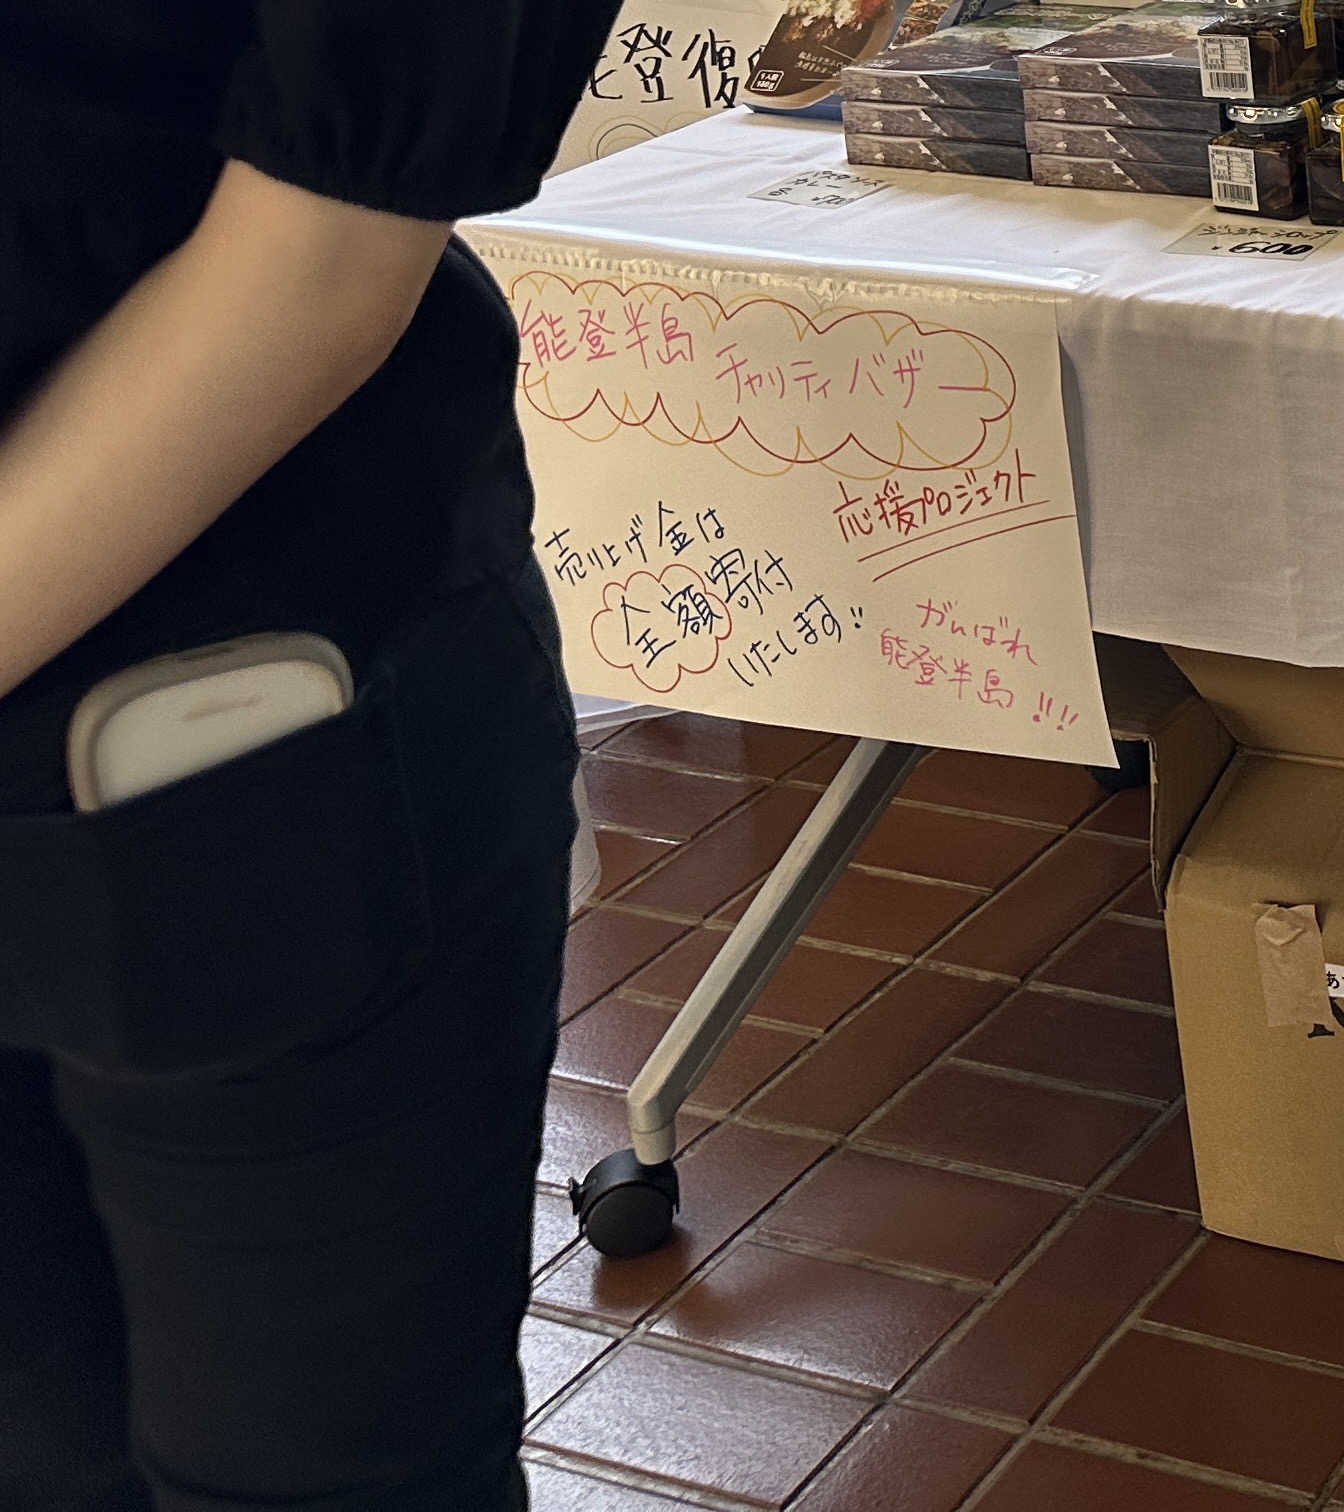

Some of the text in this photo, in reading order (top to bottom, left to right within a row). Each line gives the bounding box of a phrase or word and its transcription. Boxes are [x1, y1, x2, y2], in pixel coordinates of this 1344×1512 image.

[833, 448, 1036, 544] 応援プロジェクト
[916, 597, 1038, 666] がんばれ
